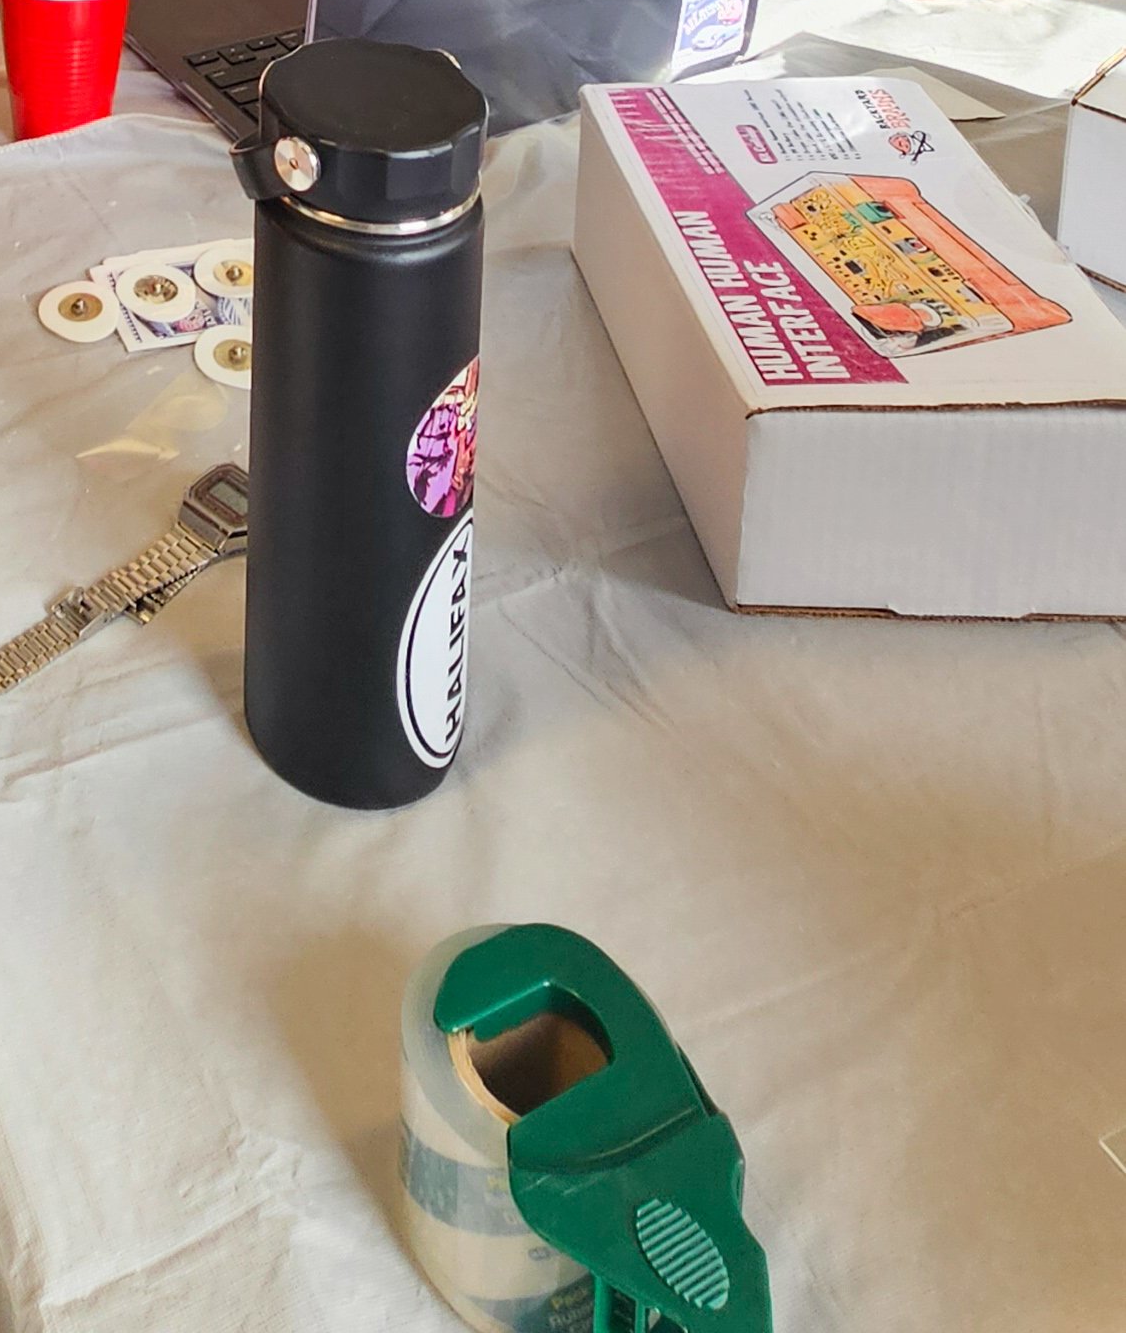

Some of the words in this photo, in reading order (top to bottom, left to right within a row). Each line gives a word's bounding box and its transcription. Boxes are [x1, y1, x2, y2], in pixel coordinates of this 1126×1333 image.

[672, 210, 750, 289] HUMAN
[718, 294, 804, 380] HUMAN
[742, 259, 851, 380] INTERFACE
[444, 531, 471, 745] HALIFAX
